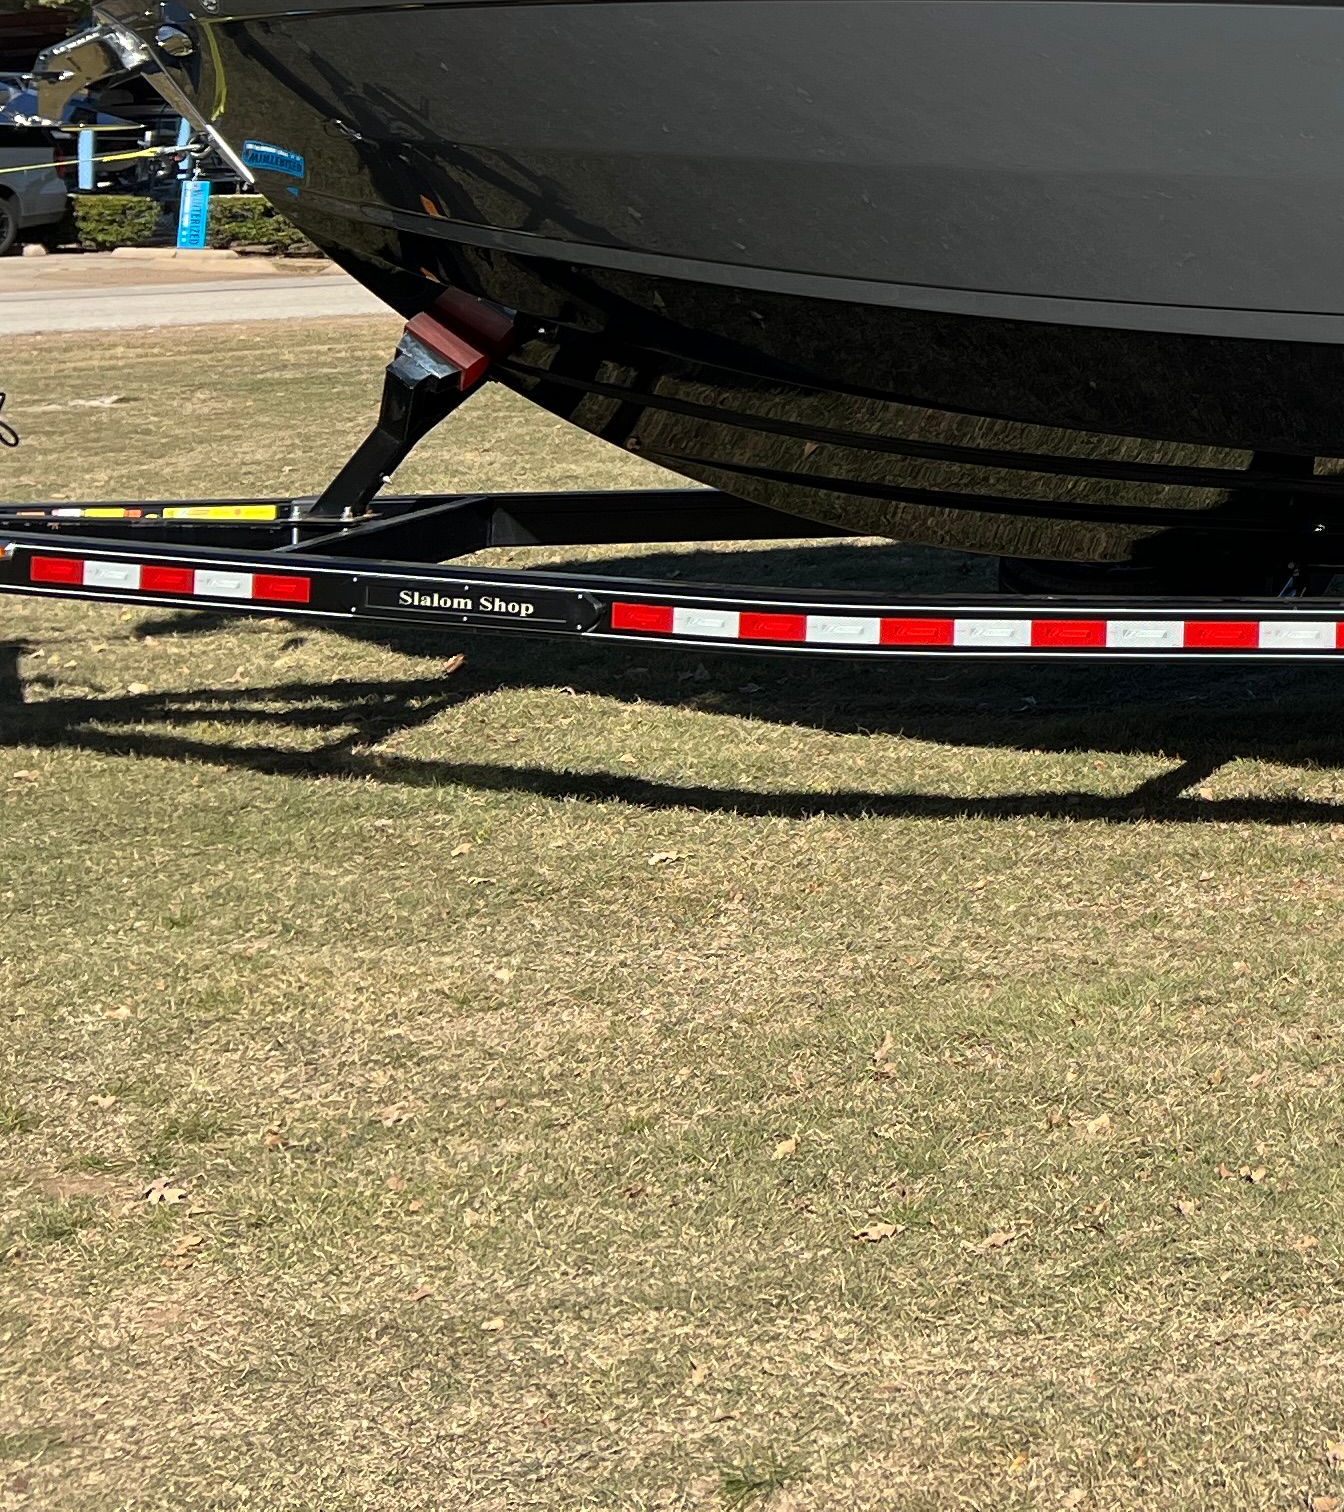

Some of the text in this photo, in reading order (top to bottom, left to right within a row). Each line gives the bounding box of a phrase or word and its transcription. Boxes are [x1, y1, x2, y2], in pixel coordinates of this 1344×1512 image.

[189, 189, 202, 245] WINTERIZED
[399, 589, 534, 617] Slalom Shop
